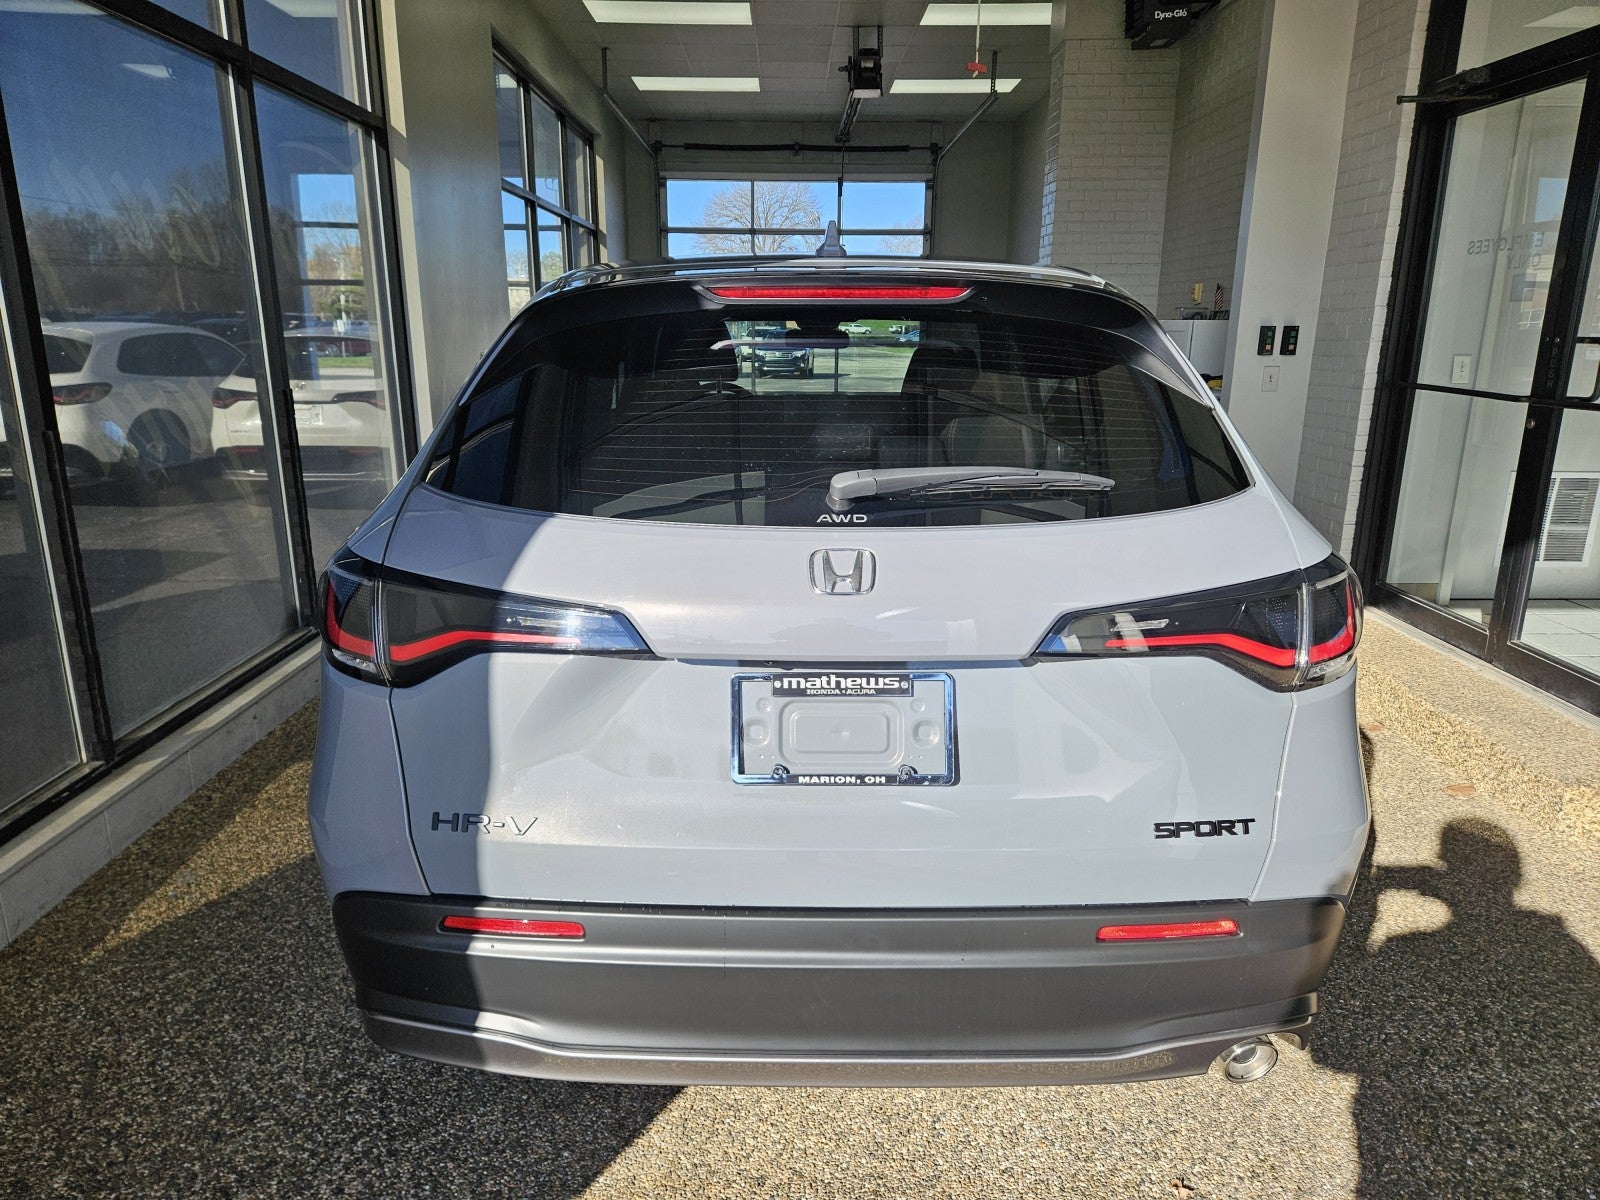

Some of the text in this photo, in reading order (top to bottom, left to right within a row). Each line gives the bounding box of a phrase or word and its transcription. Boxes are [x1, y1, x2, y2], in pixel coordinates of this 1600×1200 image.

[1154, 8, 1188, 20] Dyna-Glo
[816, 514, 868, 523] AWD
[783, 674, 900, 689] mathews
[798, 776, 886, 785] MARION, OH
[431, 811, 538, 836] HR-V
[1153, 818, 1256, 840] SPORT
